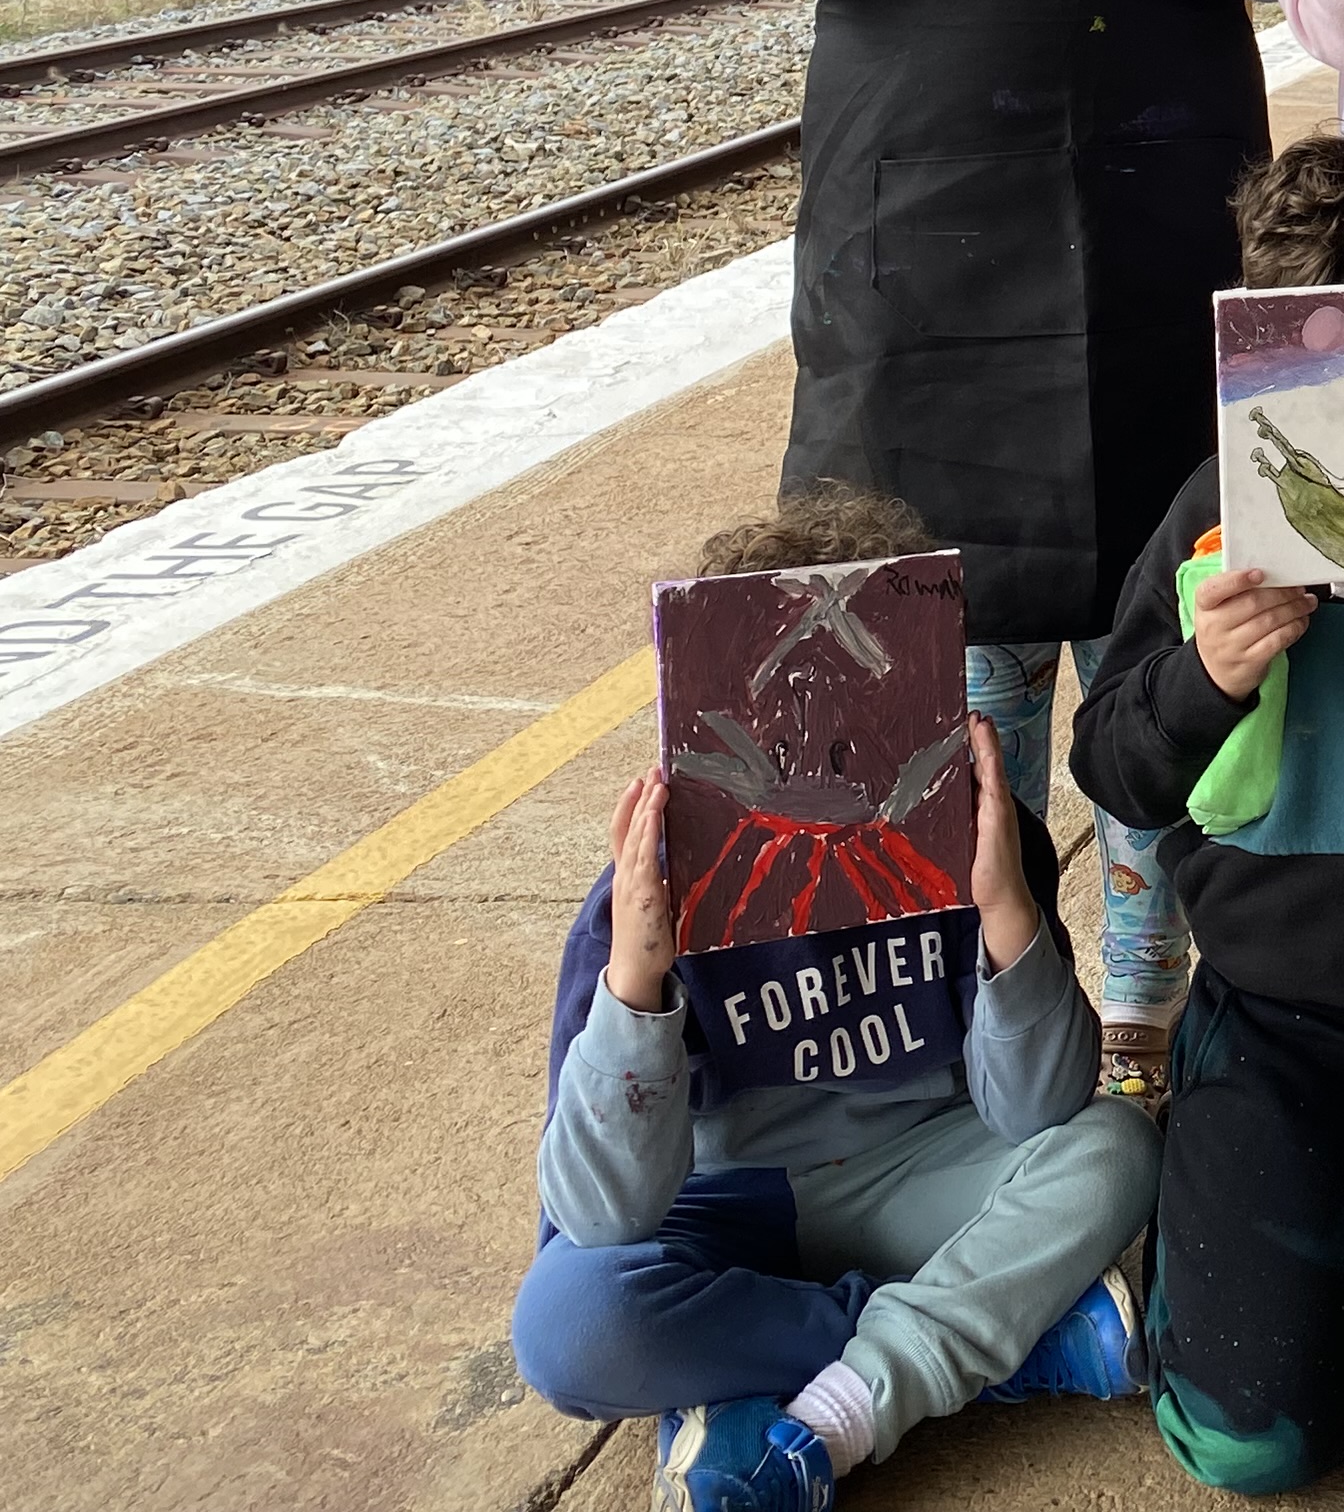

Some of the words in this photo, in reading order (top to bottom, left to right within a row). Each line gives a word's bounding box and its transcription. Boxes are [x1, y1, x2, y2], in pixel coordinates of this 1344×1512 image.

[45, 531, 304, 610] THE
[241, 458, 433, 523] GAP
[723, 930, 946, 1047] FOREVER
[793, 1003, 926, 1083] COOL
